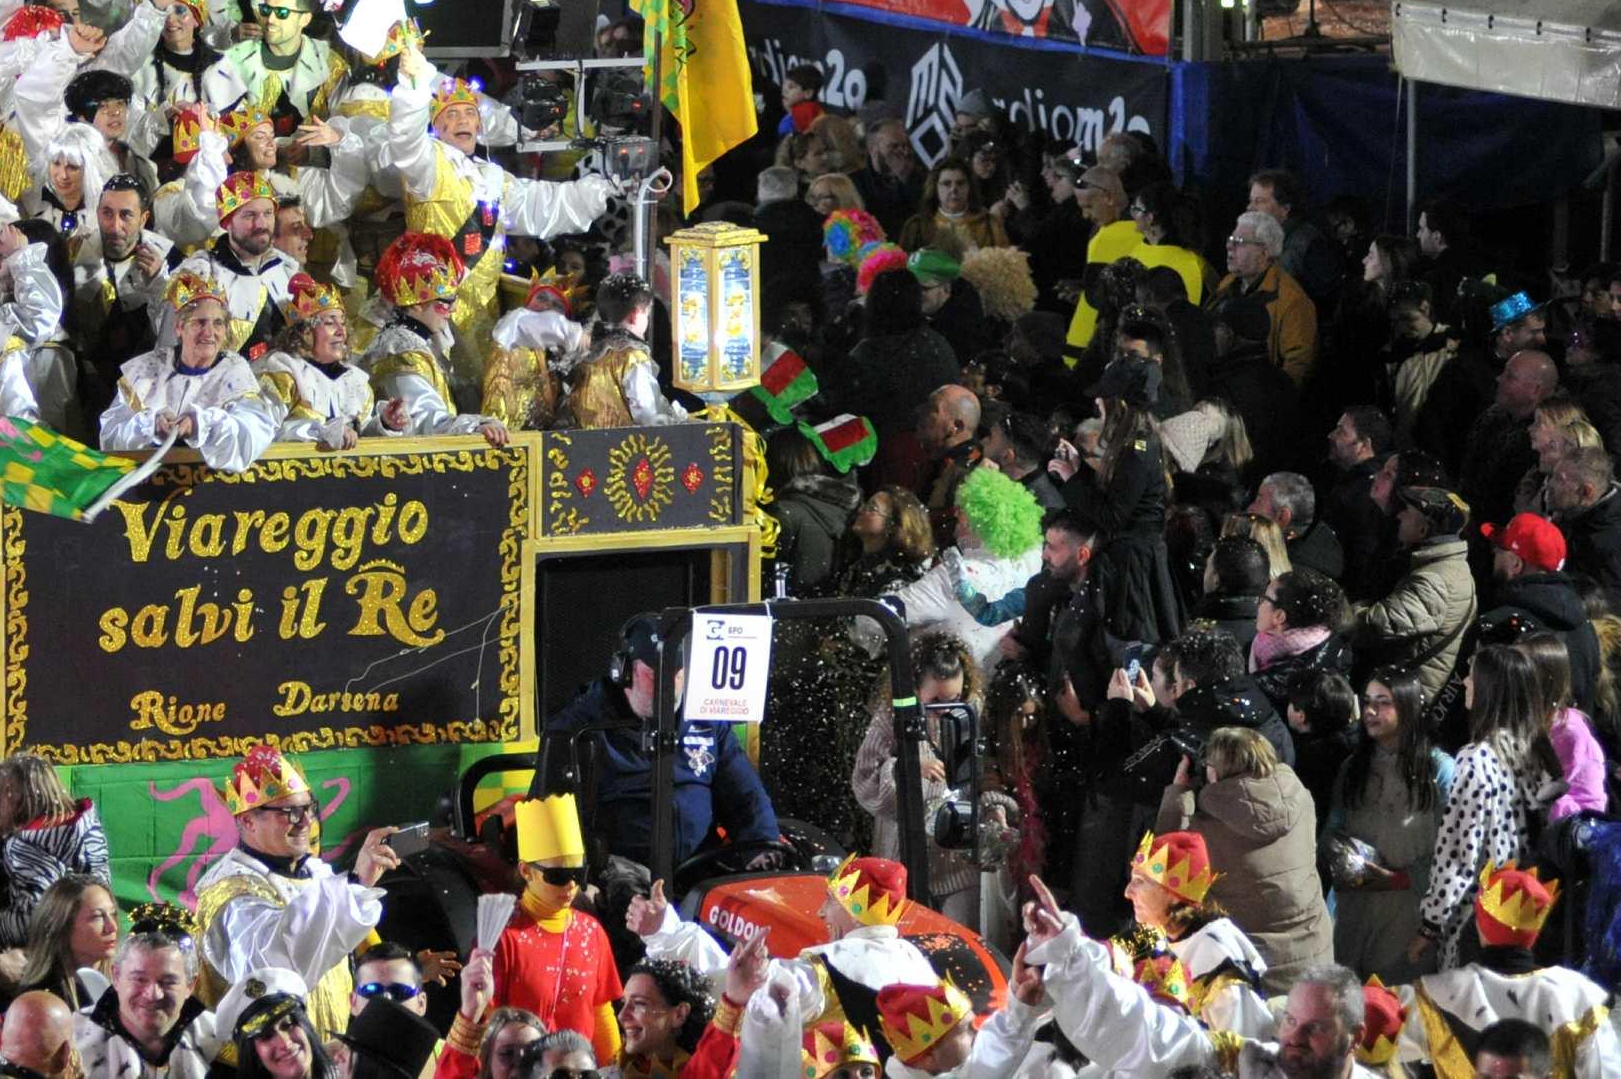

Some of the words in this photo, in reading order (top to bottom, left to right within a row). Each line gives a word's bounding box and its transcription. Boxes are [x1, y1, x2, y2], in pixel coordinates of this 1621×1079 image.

[108, 488, 428, 571] Viareggio
[98, 583, 254, 653] salvi
[278, 577, 328, 640] il
[345, 568, 446, 648] Re
[711, 645, 747, 690] 09
[130, 690, 226, 736] Rione
[272, 681, 400, 717] Darsena
[708, 905, 766, 942] GOLDO
